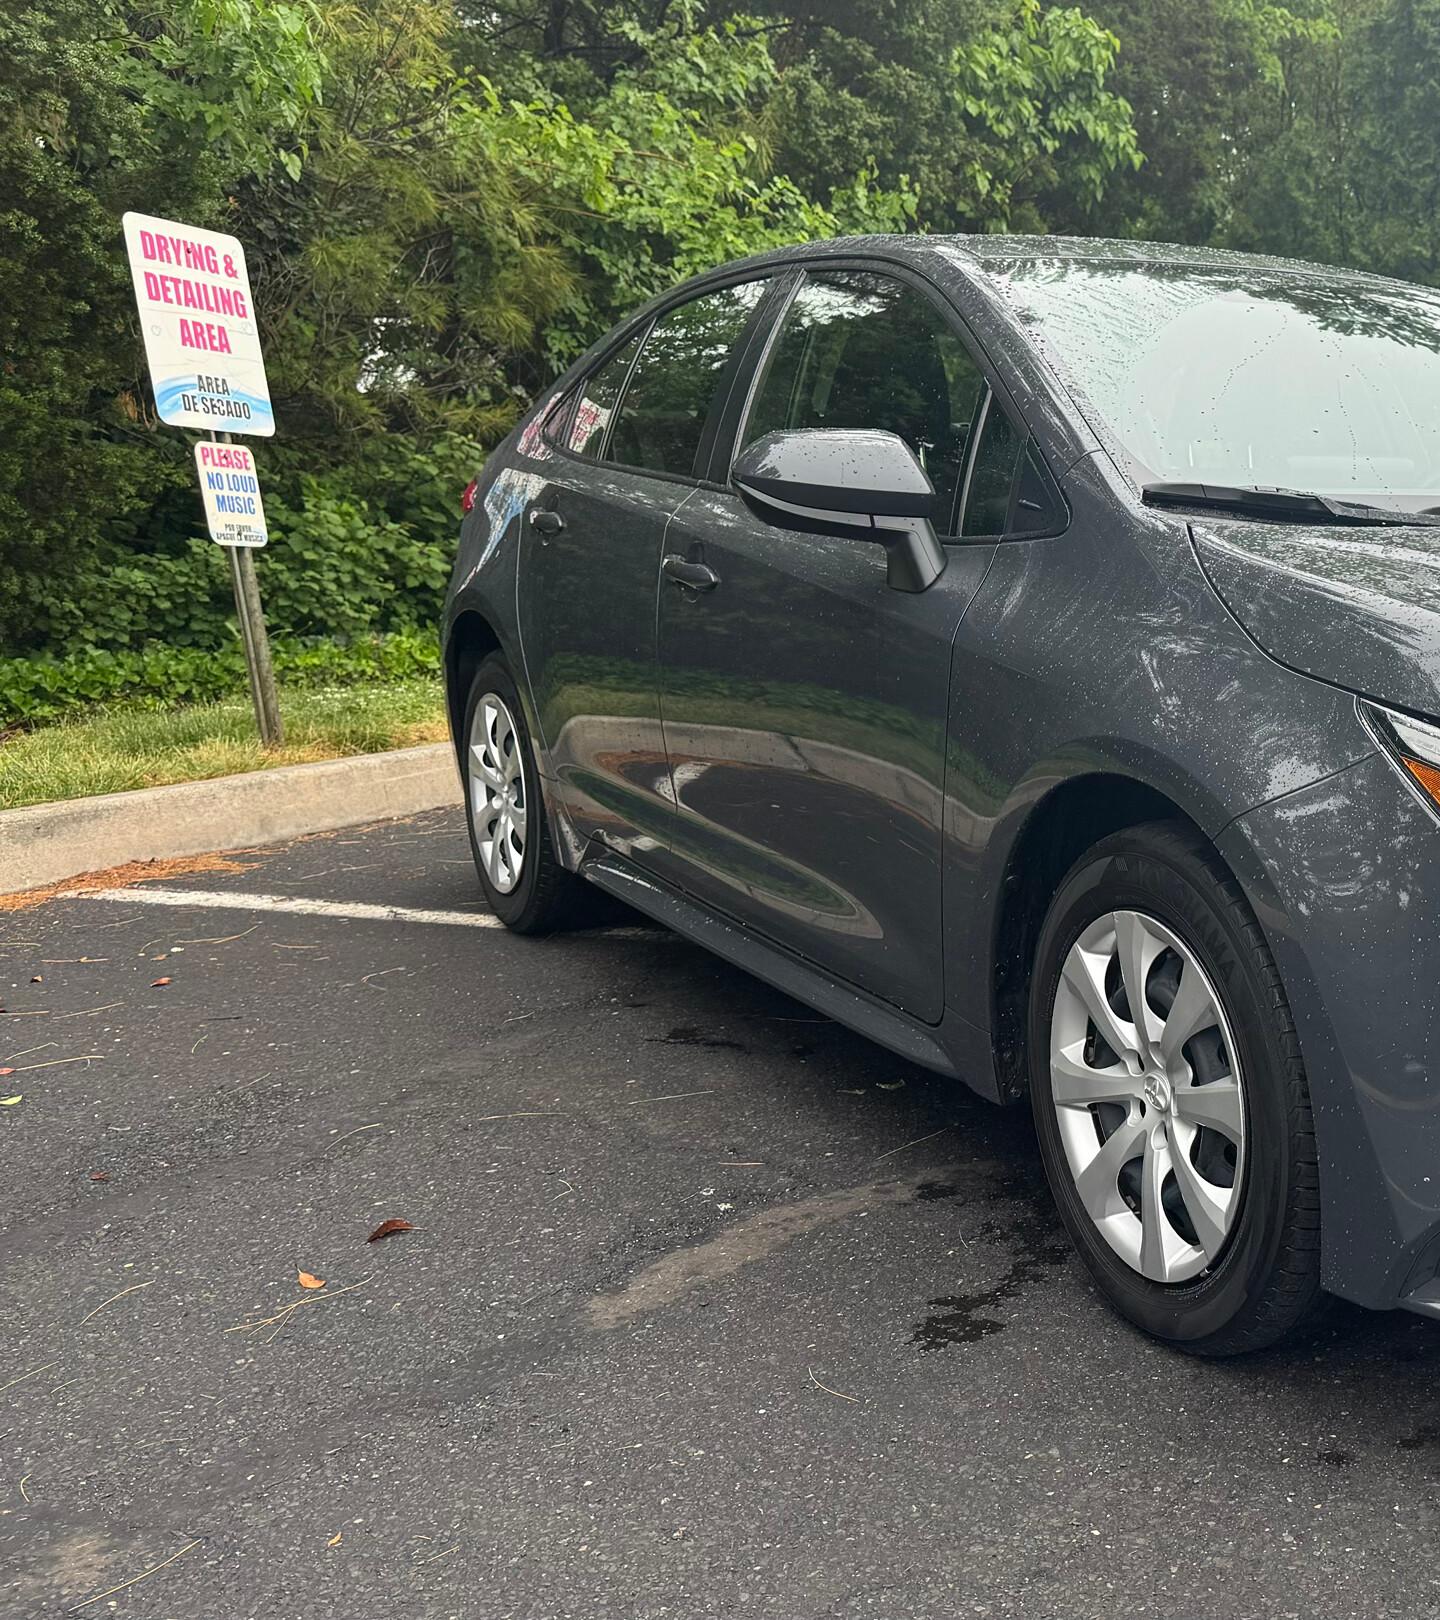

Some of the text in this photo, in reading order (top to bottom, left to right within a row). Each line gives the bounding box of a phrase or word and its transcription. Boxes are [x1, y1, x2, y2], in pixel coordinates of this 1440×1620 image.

[140, 230, 239, 280] DRYING &
[143, 270, 249, 319] DETAILING
[179, 319, 233, 354] AREA
[197, 375, 230, 396] AREA
[182, 394, 252, 420] DE SECADO
[200, 447, 251, 471] PLEASE
[207, 471, 257, 494] NO LOUD
[215, 494, 256, 515] MUSIC
